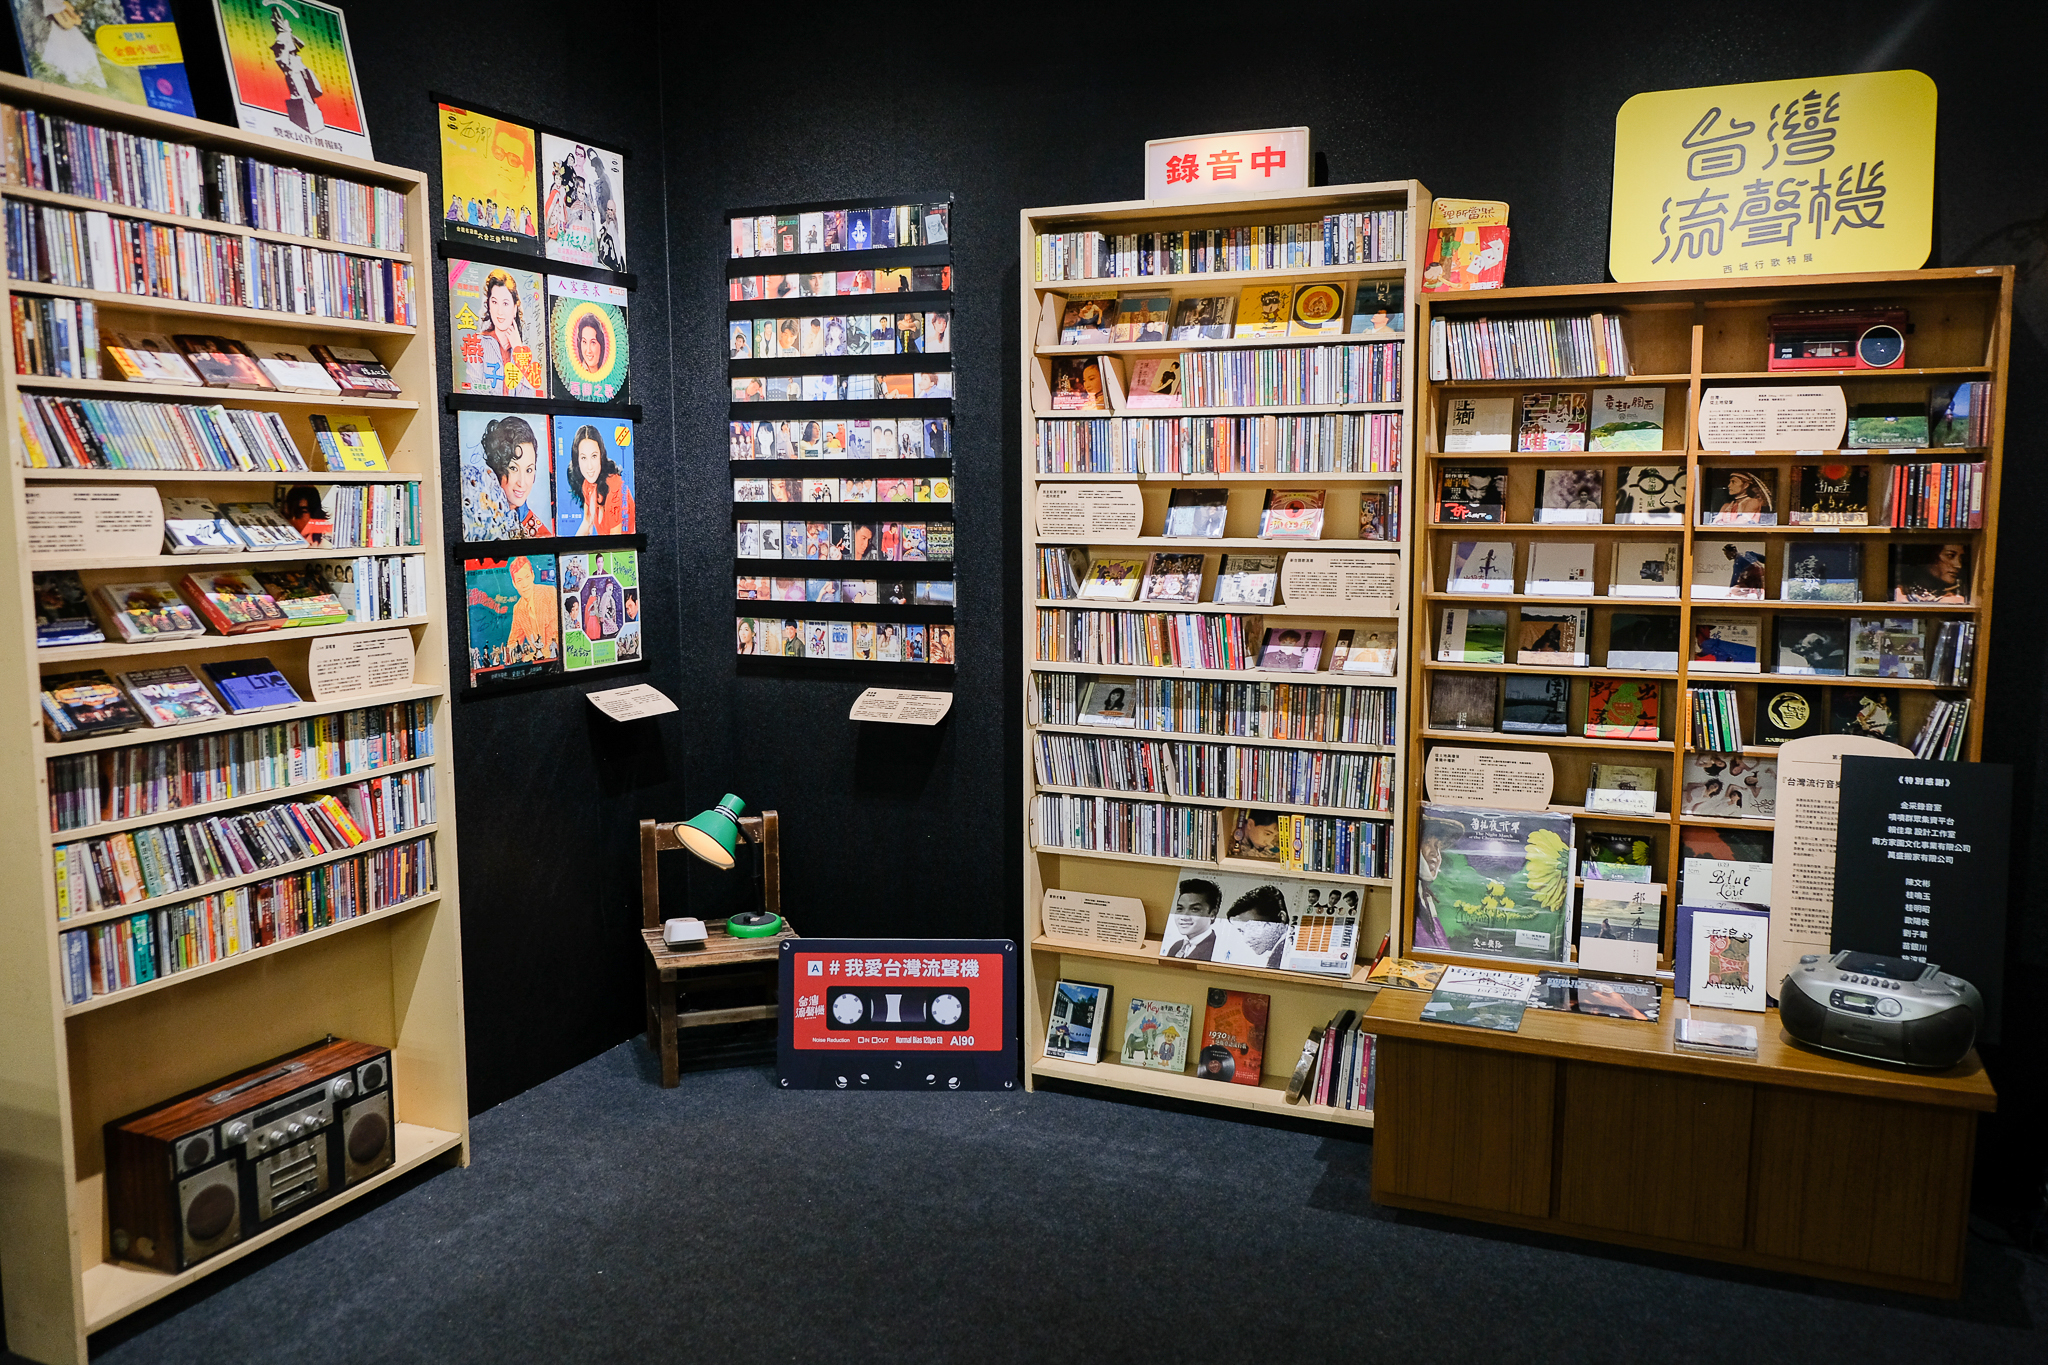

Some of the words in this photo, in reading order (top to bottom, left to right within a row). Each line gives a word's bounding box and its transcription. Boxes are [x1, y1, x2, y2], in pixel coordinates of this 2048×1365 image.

[1681, 88, 1840, 181] 台灣
[1165, 145, 1286, 185] 錄音中
[1651, 159, 1887, 265] 流聲機
[1722, 253, 1815, 275] 西城行歌特展
[1709, 869, 1751, 887] Blue
[1716, 883, 1745, 900] Love
[810, 963, 820, 973] A
[828, 960, 840, 976] #
[844, 958, 980, 978] 我愛台灣流聲機
[1146, 1001, 1160, 1015] Key
[895, 1036, 912, 1044] Normal
[912, 1036, 923, 1044] Bias
